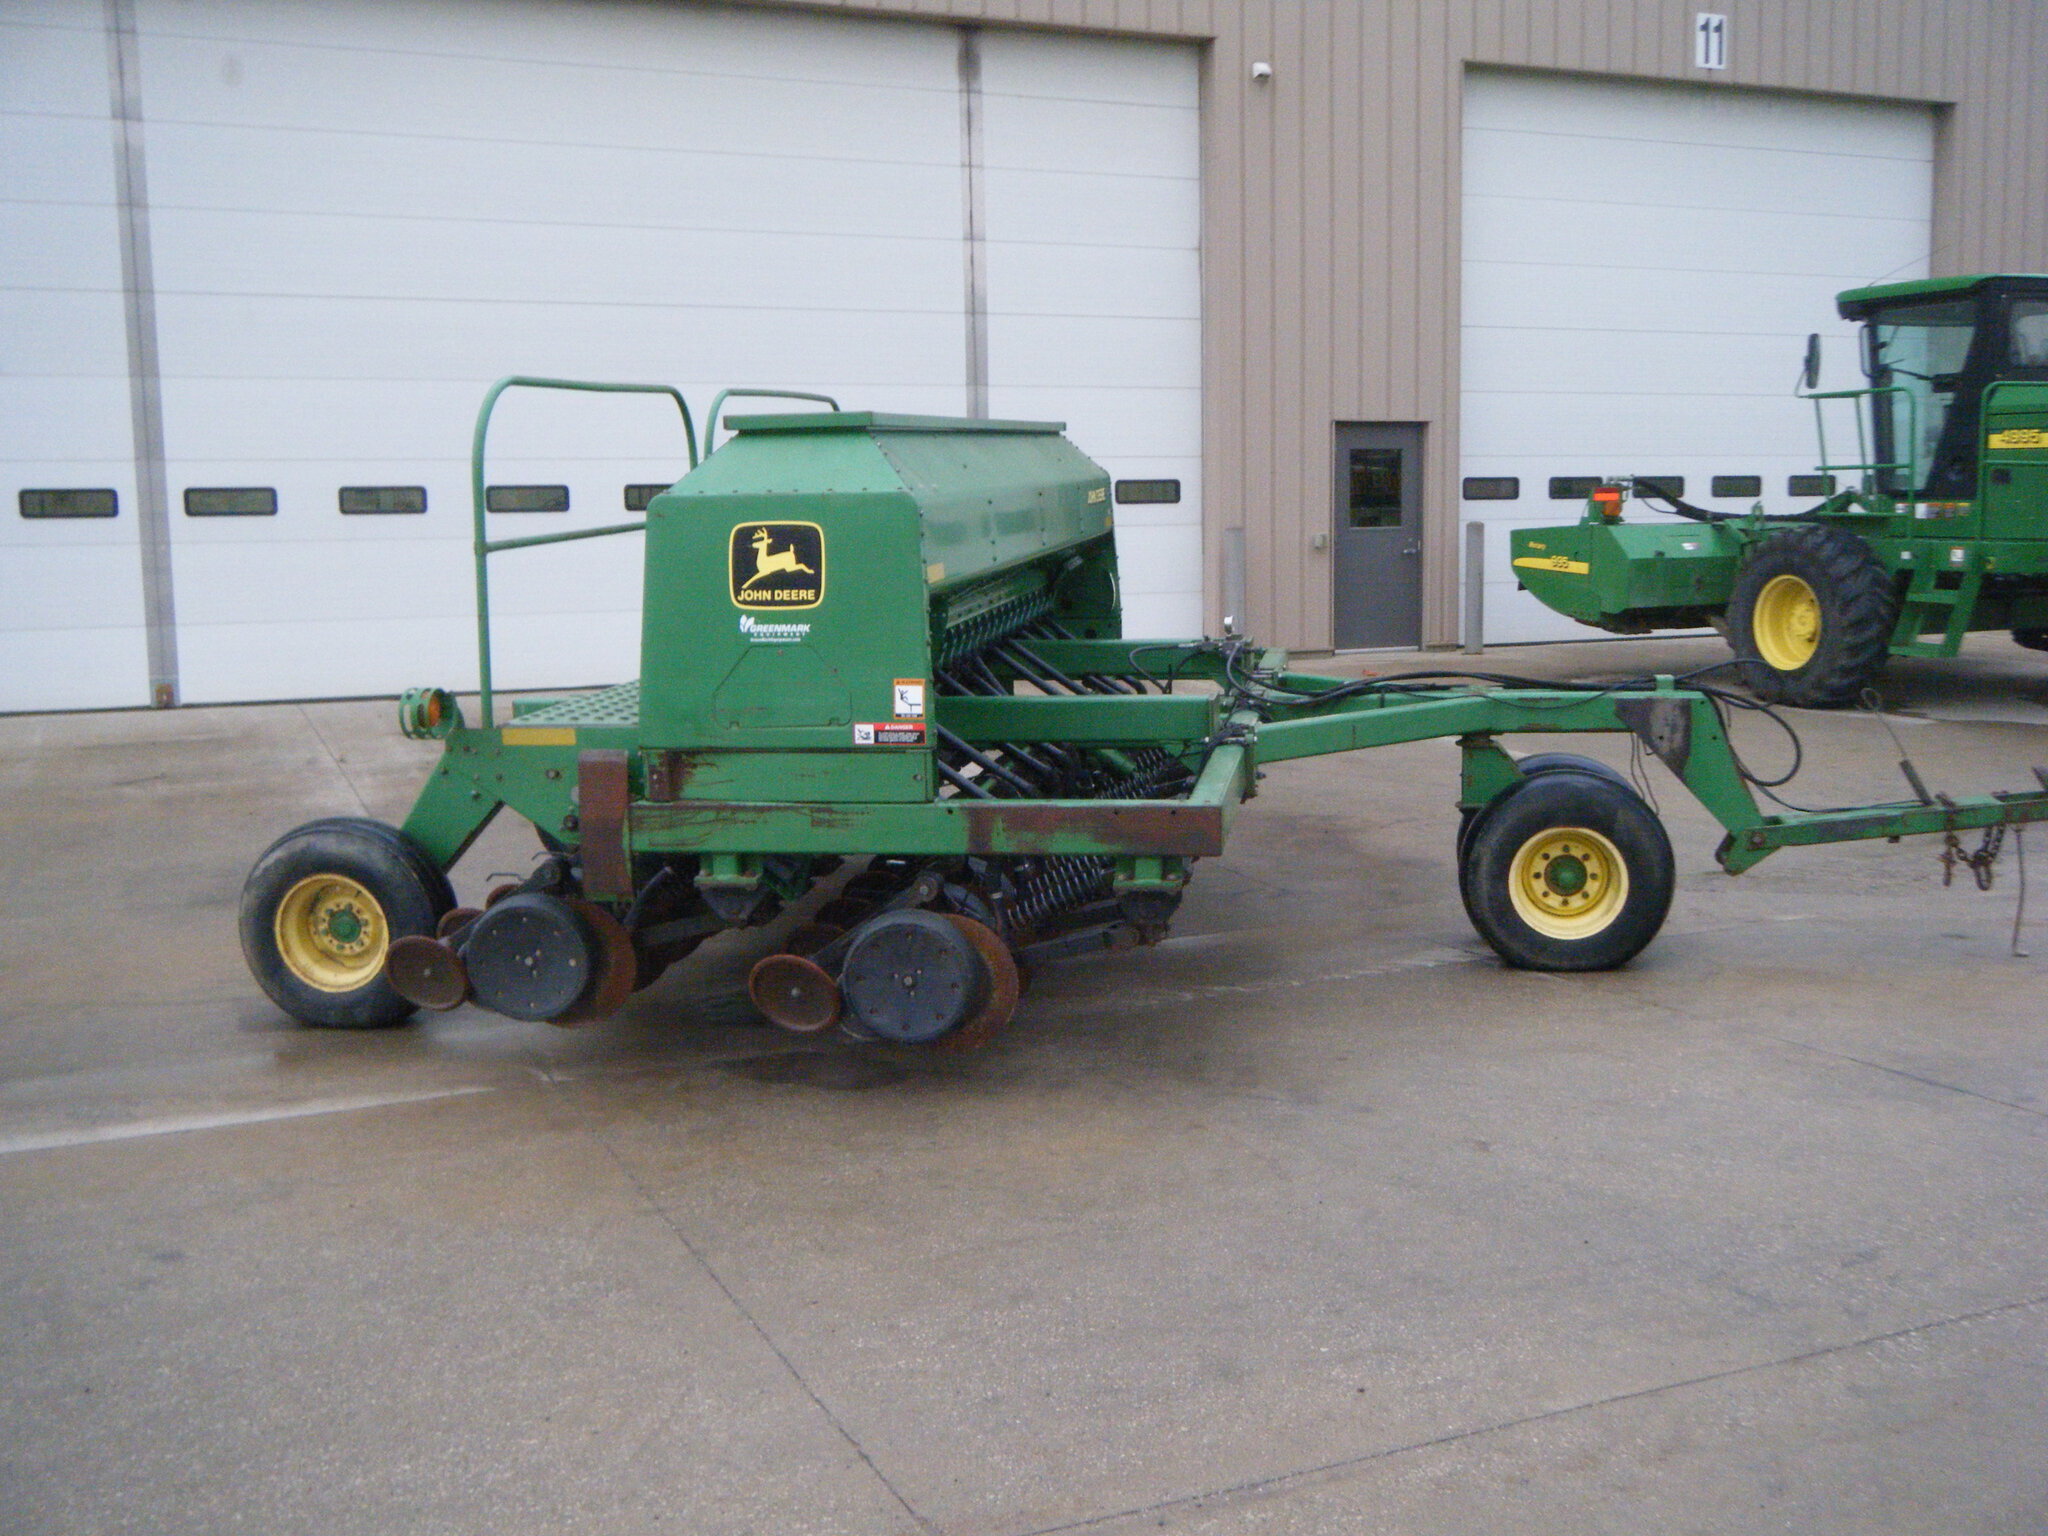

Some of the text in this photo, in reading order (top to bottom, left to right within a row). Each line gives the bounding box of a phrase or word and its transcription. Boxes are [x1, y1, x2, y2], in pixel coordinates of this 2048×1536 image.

[1699, 17, 1723, 65] 11
[2000, 429, 2039, 444] 4995
[1551, 555, 1569, 569] 995
[737, 589, 815, 601] JOHN DEERE
[749, 623, 811, 633] GREENMARK
